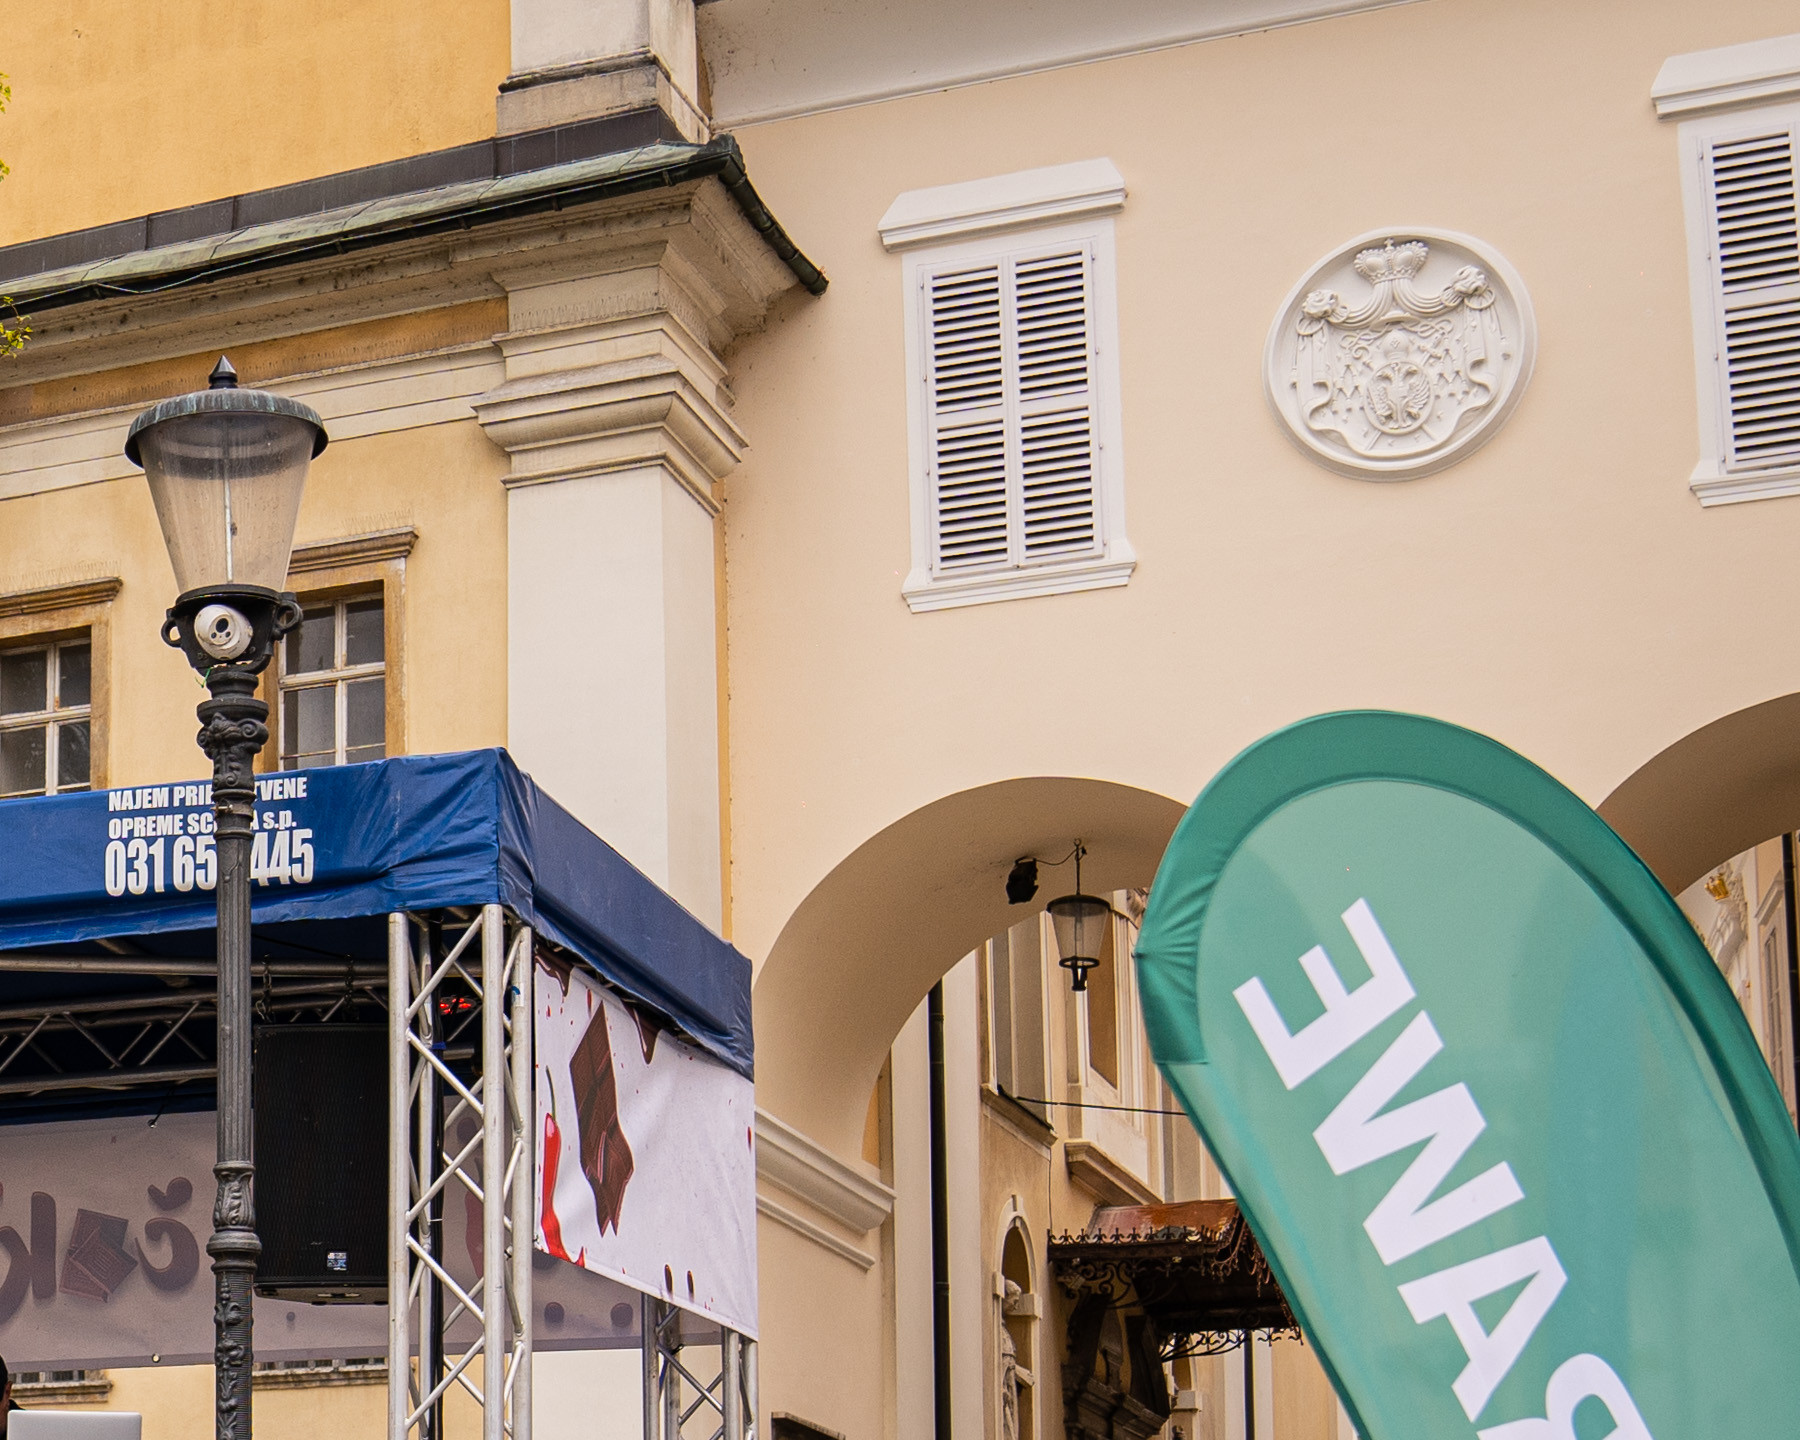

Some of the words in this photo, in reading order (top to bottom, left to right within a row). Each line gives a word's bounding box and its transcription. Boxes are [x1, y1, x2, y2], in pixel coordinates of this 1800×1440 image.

[109, 787, 169, 812] NAJEM
[108, 814, 183, 840] OPREME
[262, 810, 298, 831] s.p.
[105, 837, 165, 897] 031
[173, 834, 217, 892] 65
[251, 828, 314, 886] 445
